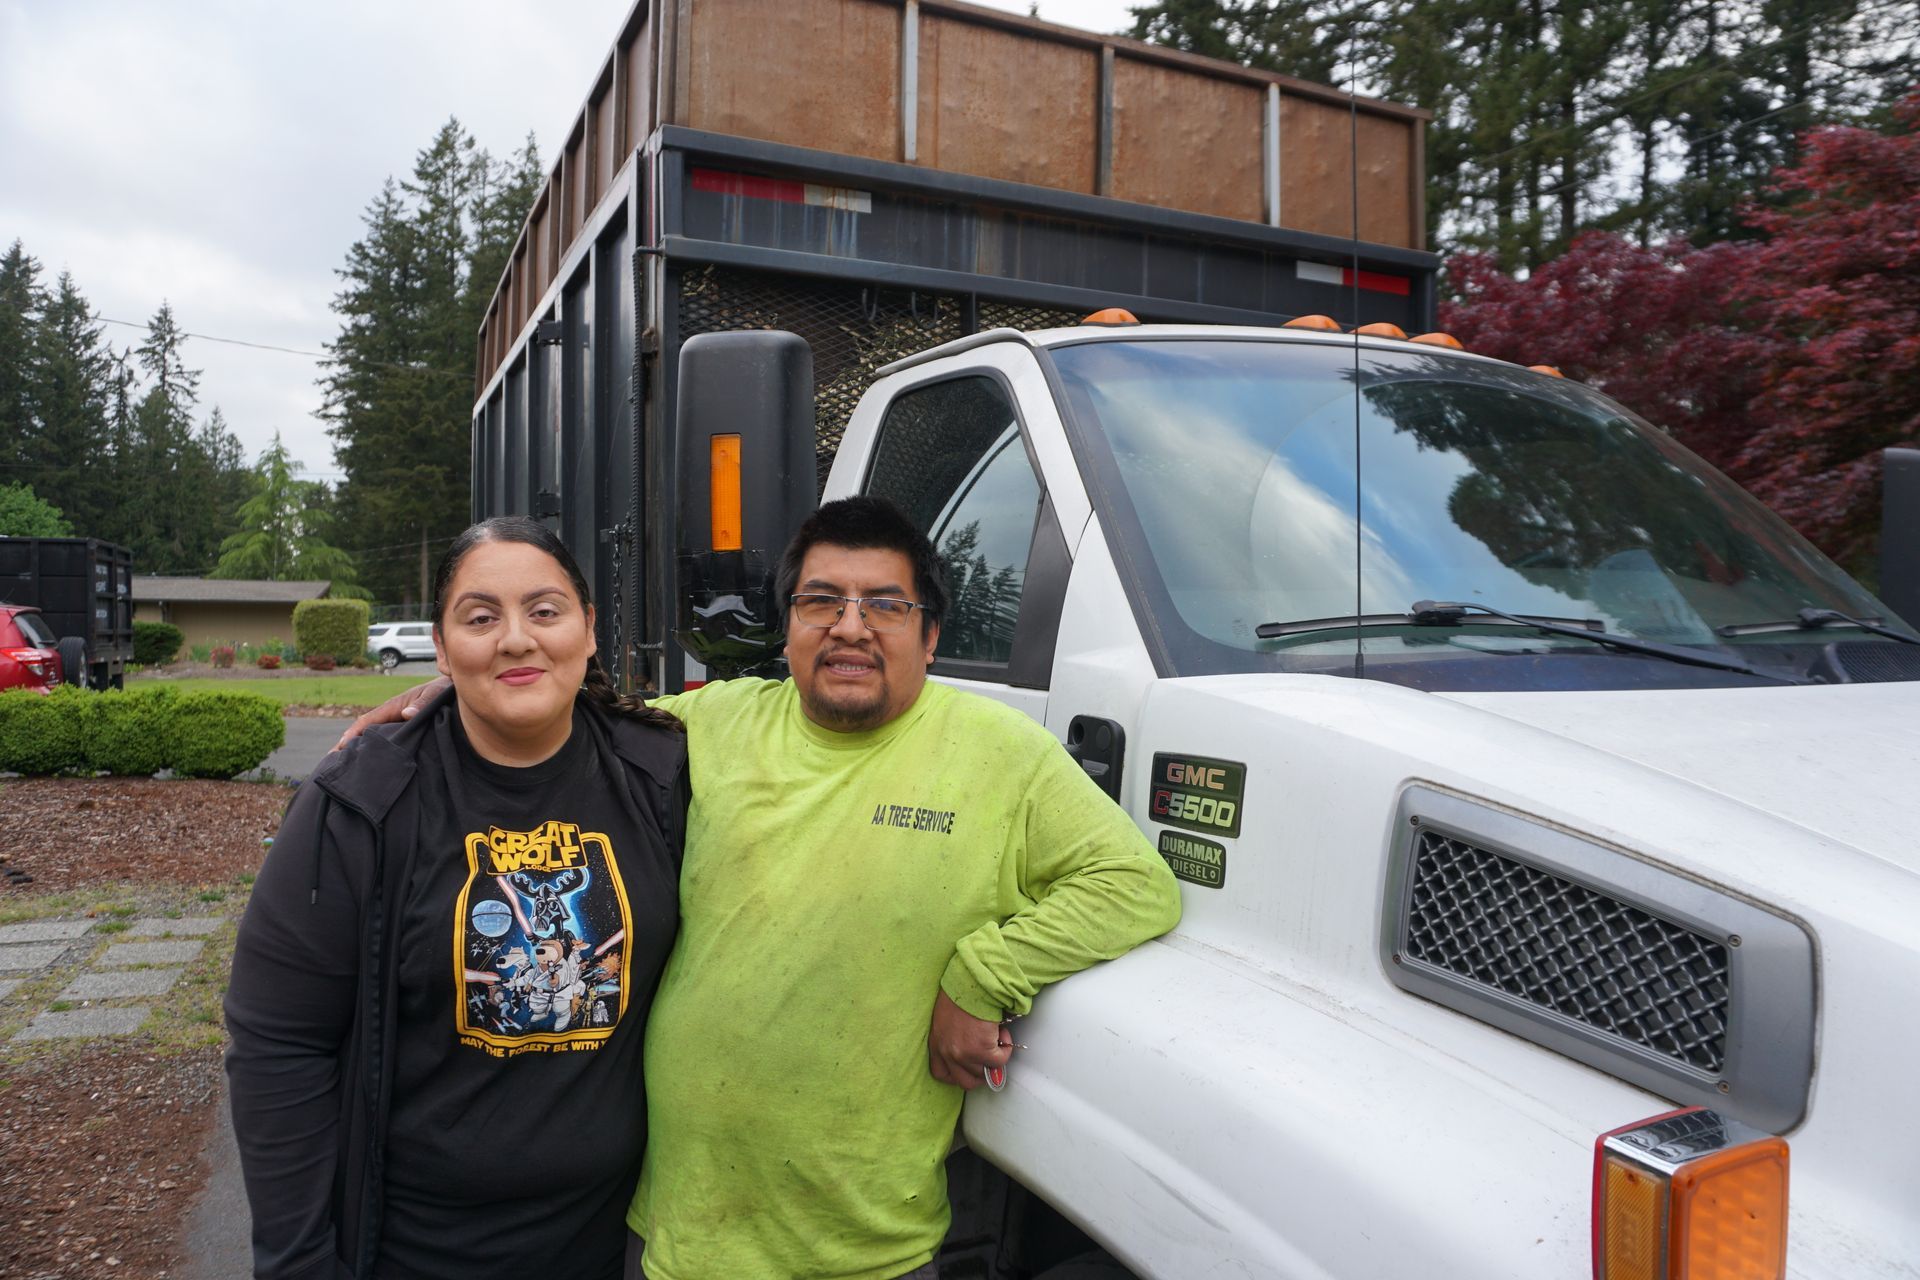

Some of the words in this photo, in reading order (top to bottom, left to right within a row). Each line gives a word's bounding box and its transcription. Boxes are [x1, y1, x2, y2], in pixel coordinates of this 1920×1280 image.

[1166, 762, 1226, 791] GMC
[871, 804, 887, 825] AA
[887, 804, 914, 828] TREE
[912, 807, 956, 835] SERVICE
[1153, 789, 1236, 828] C5500
[489, 821, 576, 854] GREAT
[1161, 834, 1223, 866] DURAMAX
[490, 843, 581, 873] WOLF
[525, 864, 552, 873] LODGE
[1172, 858, 1208, 880] DIESEL
[460, 1036, 484, 1049] MAY
[484, 1043, 505, 1058] THE
[508, 1043, 551, 1058] FOREST
[552, 1042, 569, 1053] BE
[570, 1040, 599, 1051] WITH
